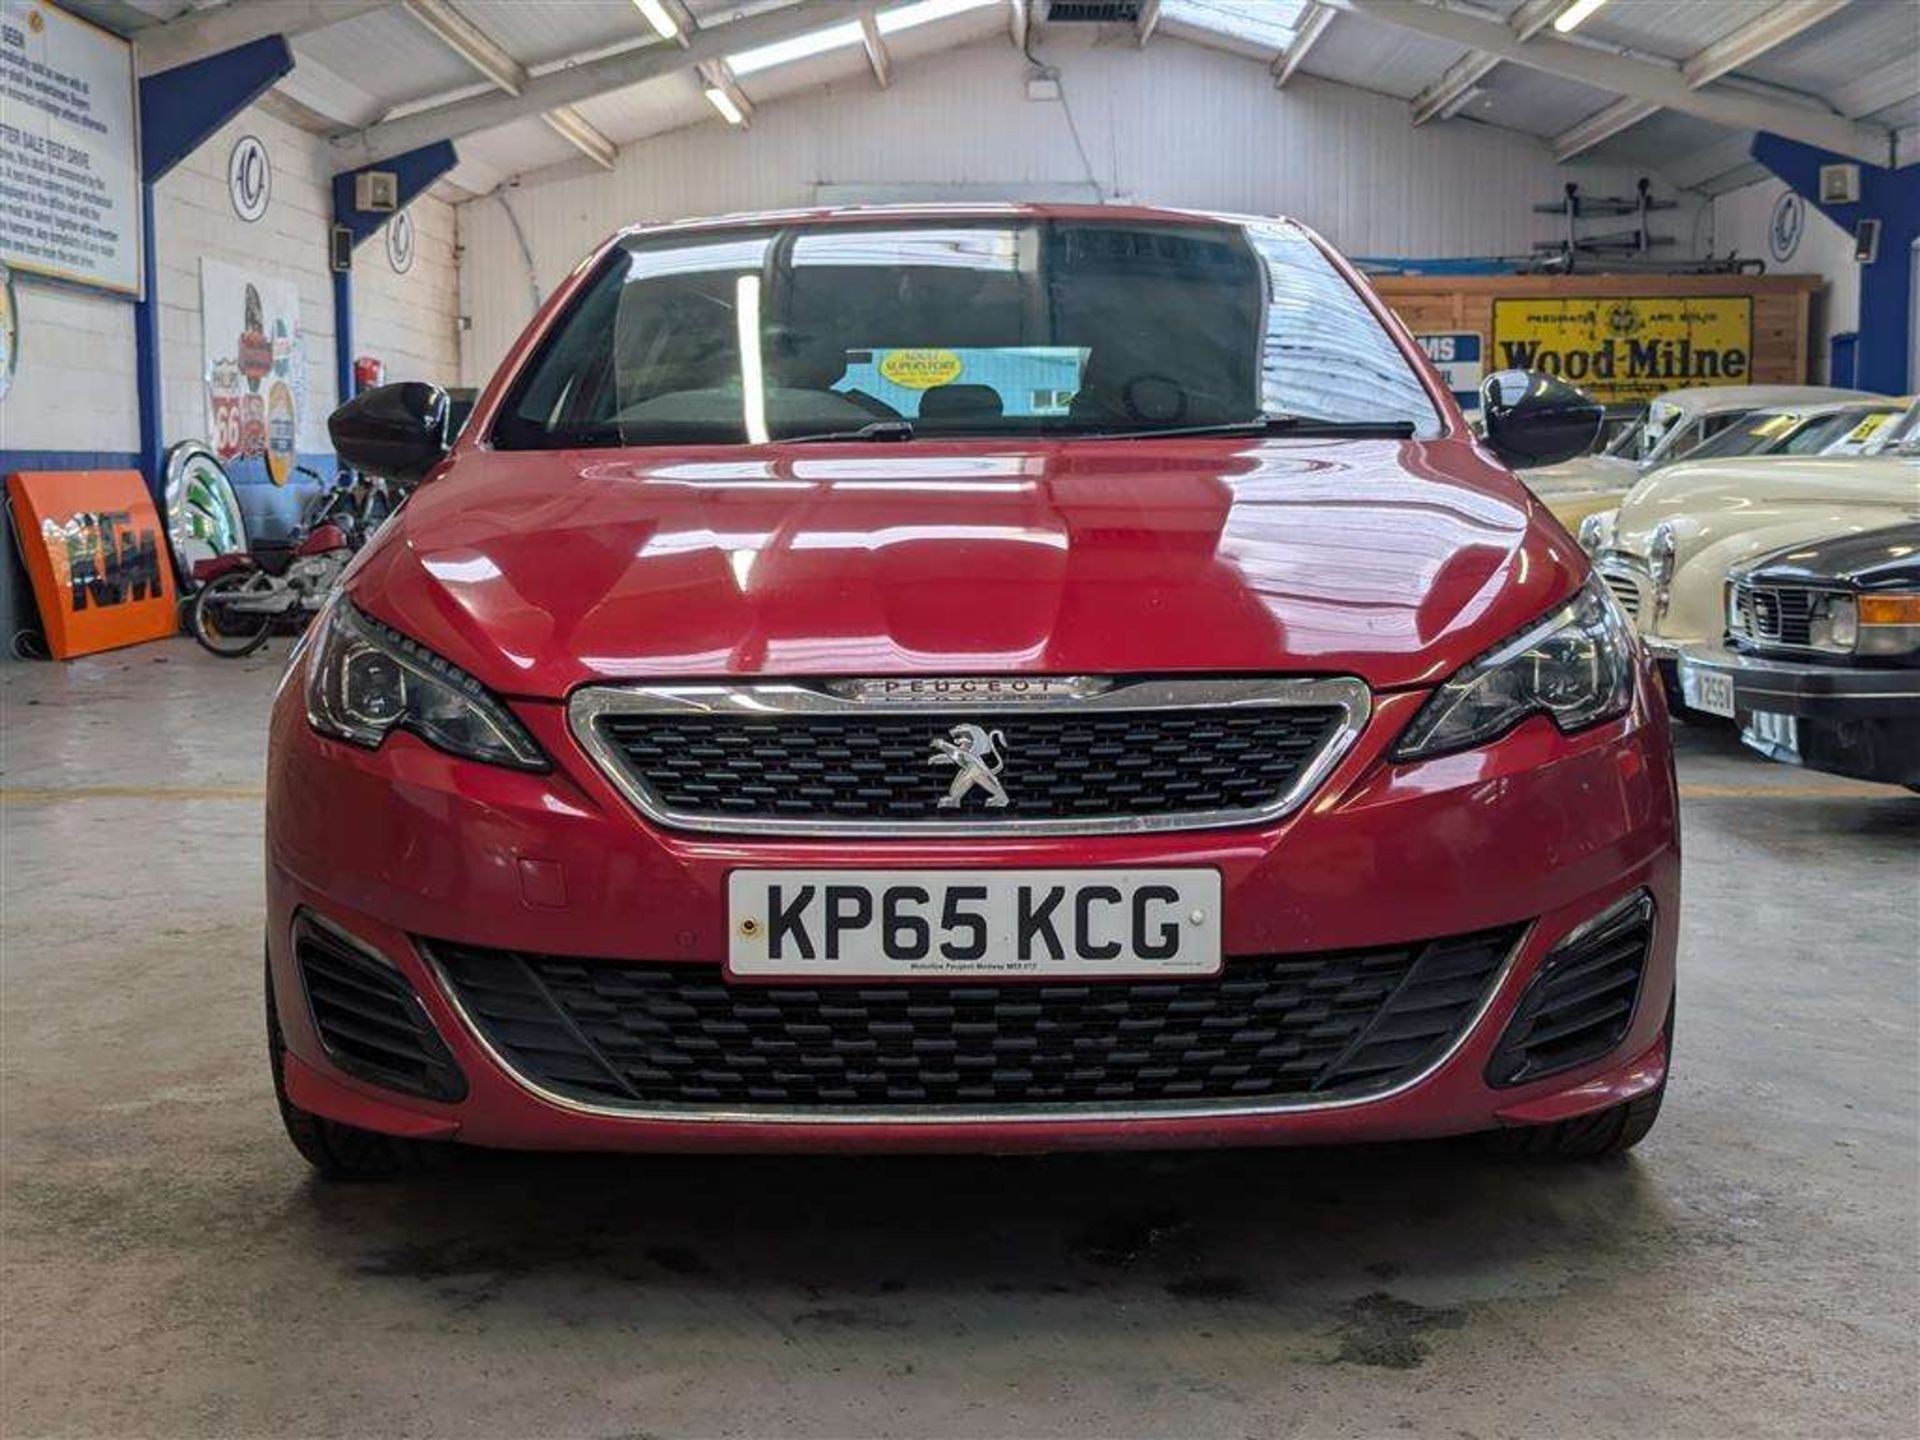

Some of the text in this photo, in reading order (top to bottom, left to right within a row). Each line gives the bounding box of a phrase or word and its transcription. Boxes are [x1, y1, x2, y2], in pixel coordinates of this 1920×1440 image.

[1498, 338, 1747, 380] Wood-Milne
[217, 405, 241, 449] 66
[884, 679, 1052, 693] PEUGEOT
[767, 885, 1180, 961] KP65 KCG
